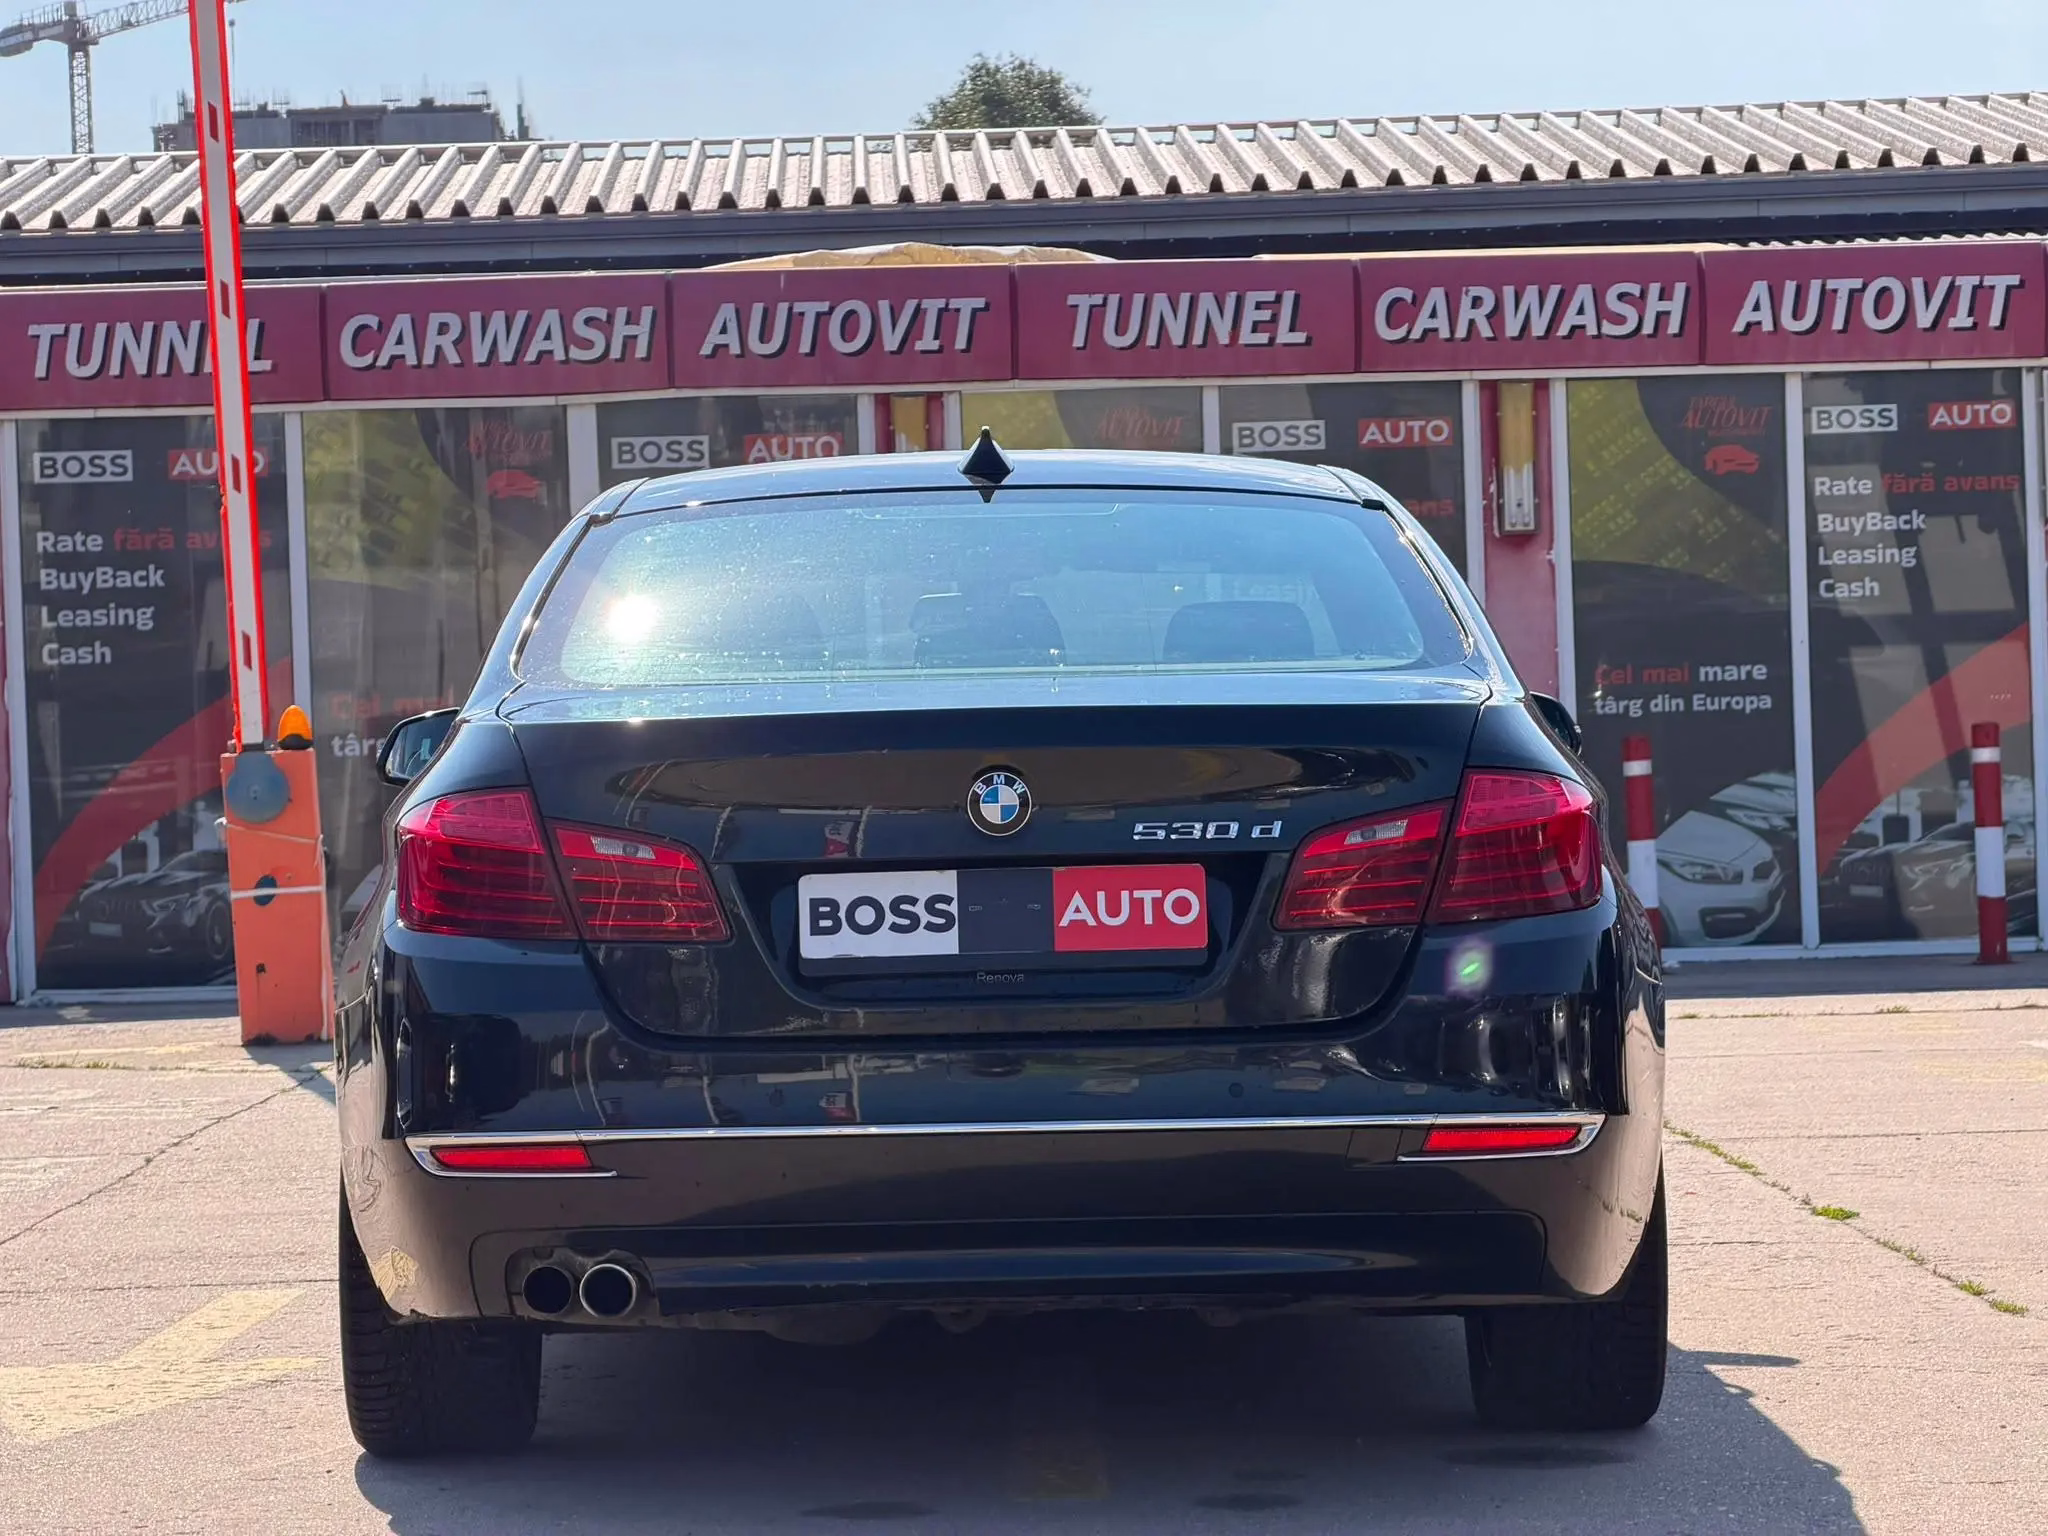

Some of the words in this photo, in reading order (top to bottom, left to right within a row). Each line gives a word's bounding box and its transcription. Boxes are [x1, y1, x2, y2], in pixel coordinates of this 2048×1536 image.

[1066, 290, 1310, 349] TUNNEL
[1374, 282, 1690, 342] CARWASH
[1731, 274, 2024, 335] AUTOVIT
[27, 318, 275, 380] TUNNL
[340, 305, 654, 369] CARWASH
[699, 297, 988, 356] AUTOVIT
[1816, 406, 1894, 430] BOSS
[1930, 402, 2012, 426] AUTO
[1237, 424, 1322, 449] BOSS
[1360, 419, 1449, 445] AUTO
[617, 438, 705, 465] BOSS
[748, 434, 840, 466] AUTO
[39, 454, 129, 479] BOSS
[1814, 476, 1873, 496] Rate
[1881, 472, 1936, 494] fără
[1944, 474, 2020, 491] avans
[1817, 509, 1927, 536] BuyBack
[36, 530, 103, 553] Rate
[1818, 543, 1918, 567] Leasing
[39, 564, 165, 594] BuyBack
[1819, 577, 1880, 598] Cash
[41, 603, 154, 630] Leasing
[42, 640, 112, 665] Cash
[1699, 664, 1768, 682] mare
[1595, 695, 1644, 717] târg
[1650, 694, 1685, 713] din
[1692, 694, 1772, 714] Europa
[973, 774, 1026, 796] BMW
[1133, 821, 1240, 840] 530
[1251, 820, 1282, 838] d
[808, 894, 957, 937] BOSS
[1057, 887, 1201, 928] AUTO
